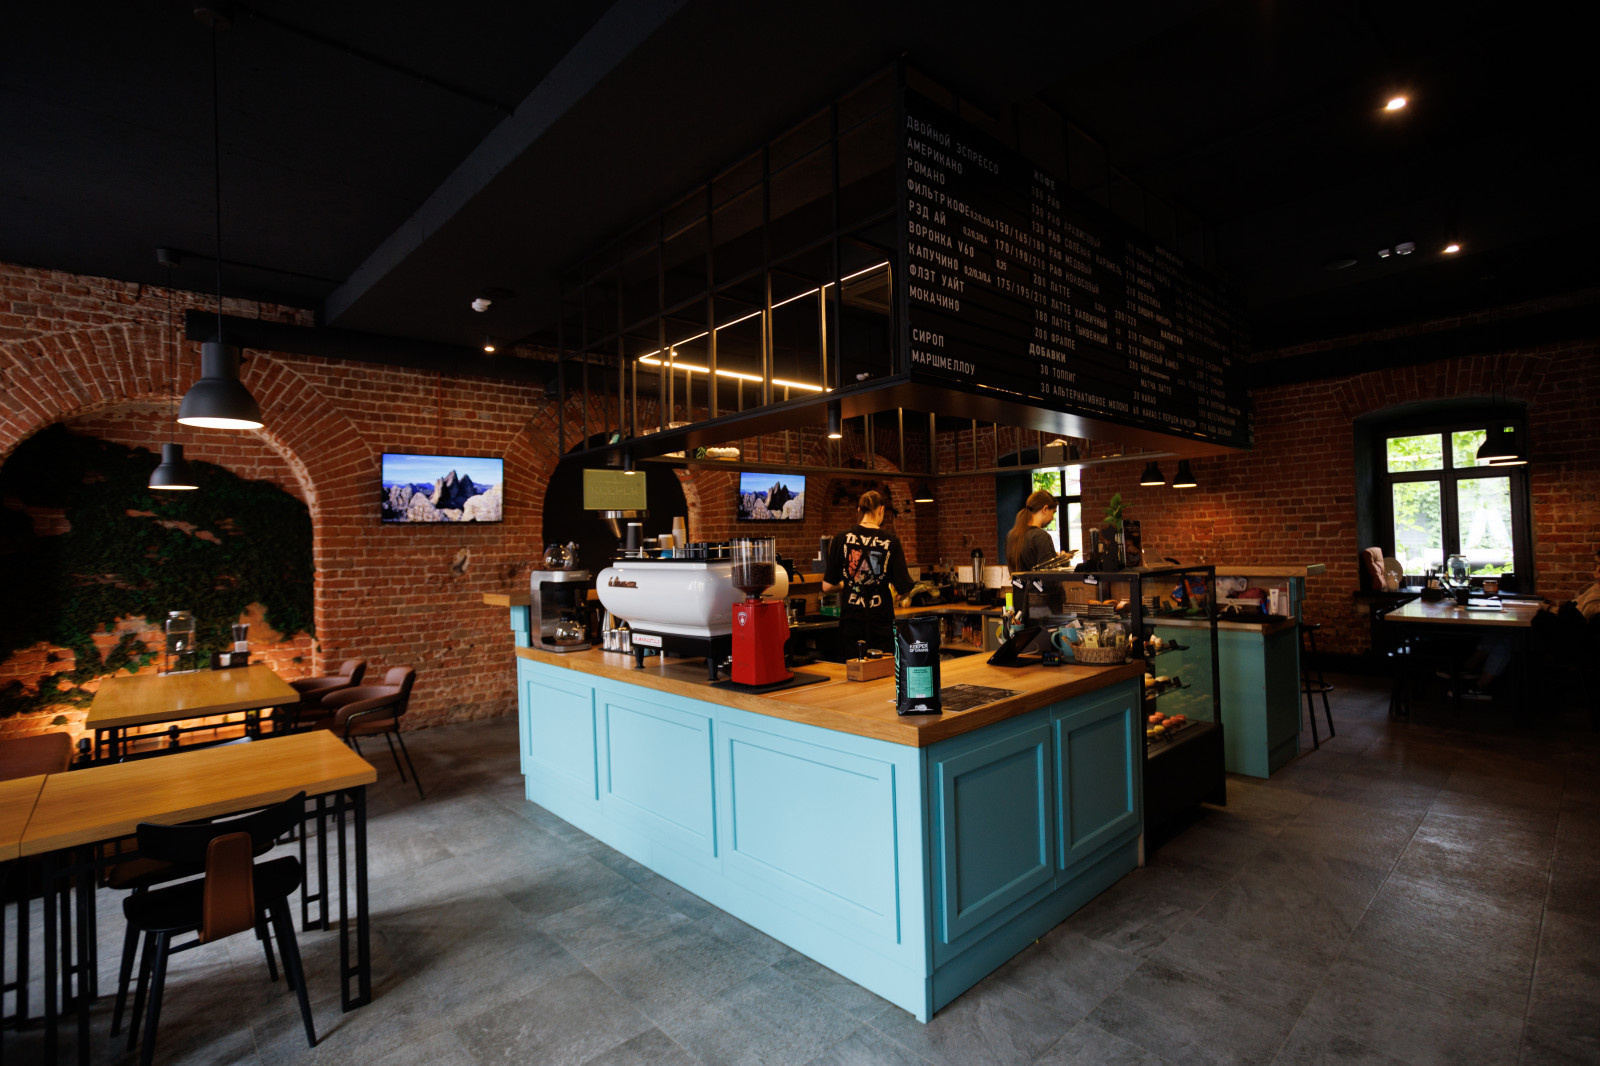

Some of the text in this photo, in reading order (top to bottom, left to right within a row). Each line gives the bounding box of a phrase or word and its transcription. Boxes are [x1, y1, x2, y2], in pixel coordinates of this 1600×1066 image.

[906, 114, 950, 148] ДВОЙНОЙ
[956, 141, 998, 175] ЭСПРЕССО
[907, 156, 945, 185] РОМАНО
[907, 136, 1043, 218] АМЕРИКАНО 130
[1033, 169, 1054, 191] КОФЕ
[907, 178, 945, 206] ФИЛЬТР
[947, 196, 969, 216] КОФЕ
[995, 218, 1044, 253] 150/165/180
[909, 199, 928, 219] РЭД
[934, 209, 945, 226] АЙ
[1047, 194, 1060, 210] РАФ
[908, 220, 952, 248] ВОРОНКА
[957, 240, 974, 257] V60
[1047, 211, 1060, 227] РАФ
[1063, 220, 1100, 248] АРАХИСОВЫЙ
[1047, 228, 1060, 244] РАФ
[908, 242, 958, 271] КАПУЧИНО
[997, 275, 1046, 305] 175/195/210
[1049, 246, 1061, 261] РАФ
[1065, 253, 1091, 275] МЕДОВЫЙ
[909, 263, 935, 282] ФЛЭТ
[942, 274, 964, 293] УАЙТ
[1049, 263, 1062, 278] РАФ
[1065, 270, 1099, 295] КОКОСОВЫЙ
[1050, 280, 1070, 298] ЛАТТЕ
[909, 285, 1047, 340] МОКАЧИНО 200
[1051, 298, 1070, 314] ЛАТТЕ
[1074, 307, 1107, 329] ХАЛВИЧНЫЙ
[912, 328, 943, 347] СИРОП
[1051, 315, 1071, 331] ЛАТТЕ
[1075, 324, 1107, 345] ТЫКВЕННЫЙ
[1051, 332, 1074, 349] ФРАППЕ
[912, 349, 974, 375] МАРШМЕЛЛОУ
[1029, 342, 1065, 364] ДОБАВКИ
[1053, 385, 1105, 407] АЛЬТЕРНАТИВНОЕ
